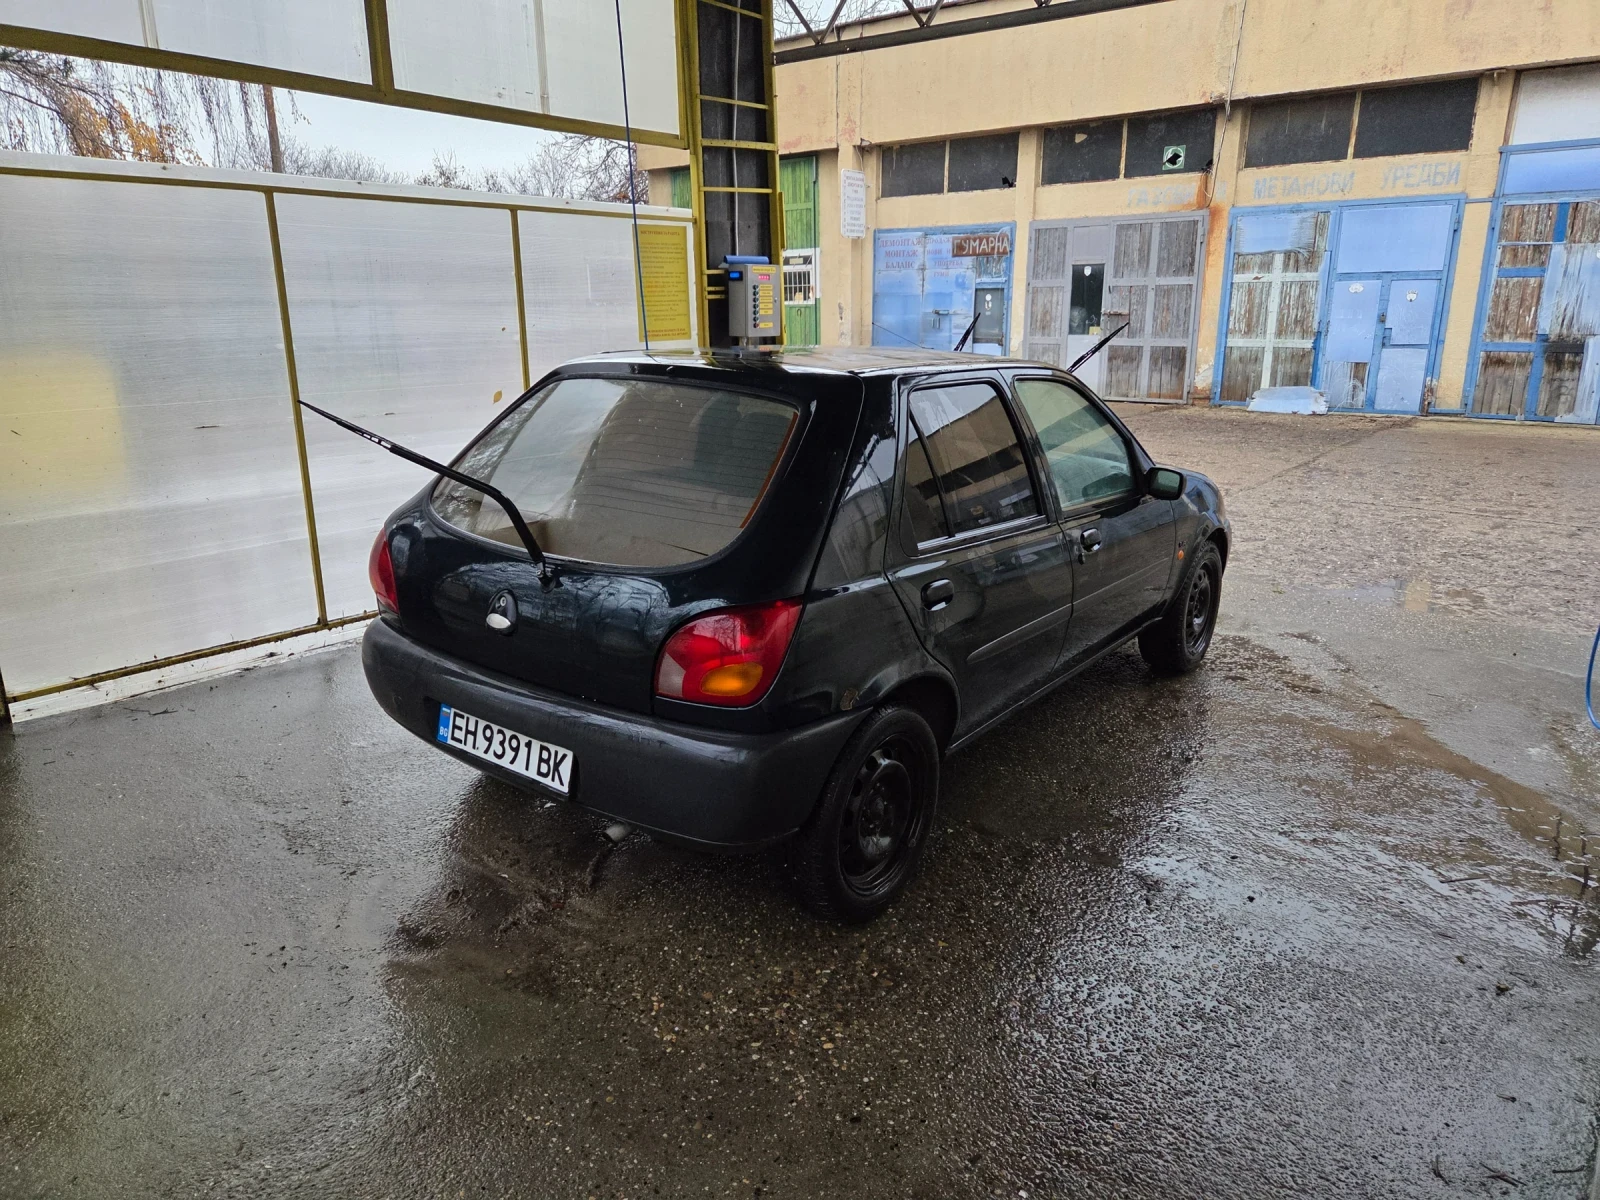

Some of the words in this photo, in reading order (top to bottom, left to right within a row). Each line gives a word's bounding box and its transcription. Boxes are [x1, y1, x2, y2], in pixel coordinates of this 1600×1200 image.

[1254, 170, 1355, 199] МЕТАНОВИ
[1380, 161, 1461, 190] УРЕДБИ
[879, 237, 922, 248] ДЕМОНТАЖ
[954, 236, 1009, 254] ГУМАРНА
[885, 250, 918, 258] МОНТАЖ
[885, 261, 915, 269] БАЛАНС
[439, 726, 449, 738] BG
